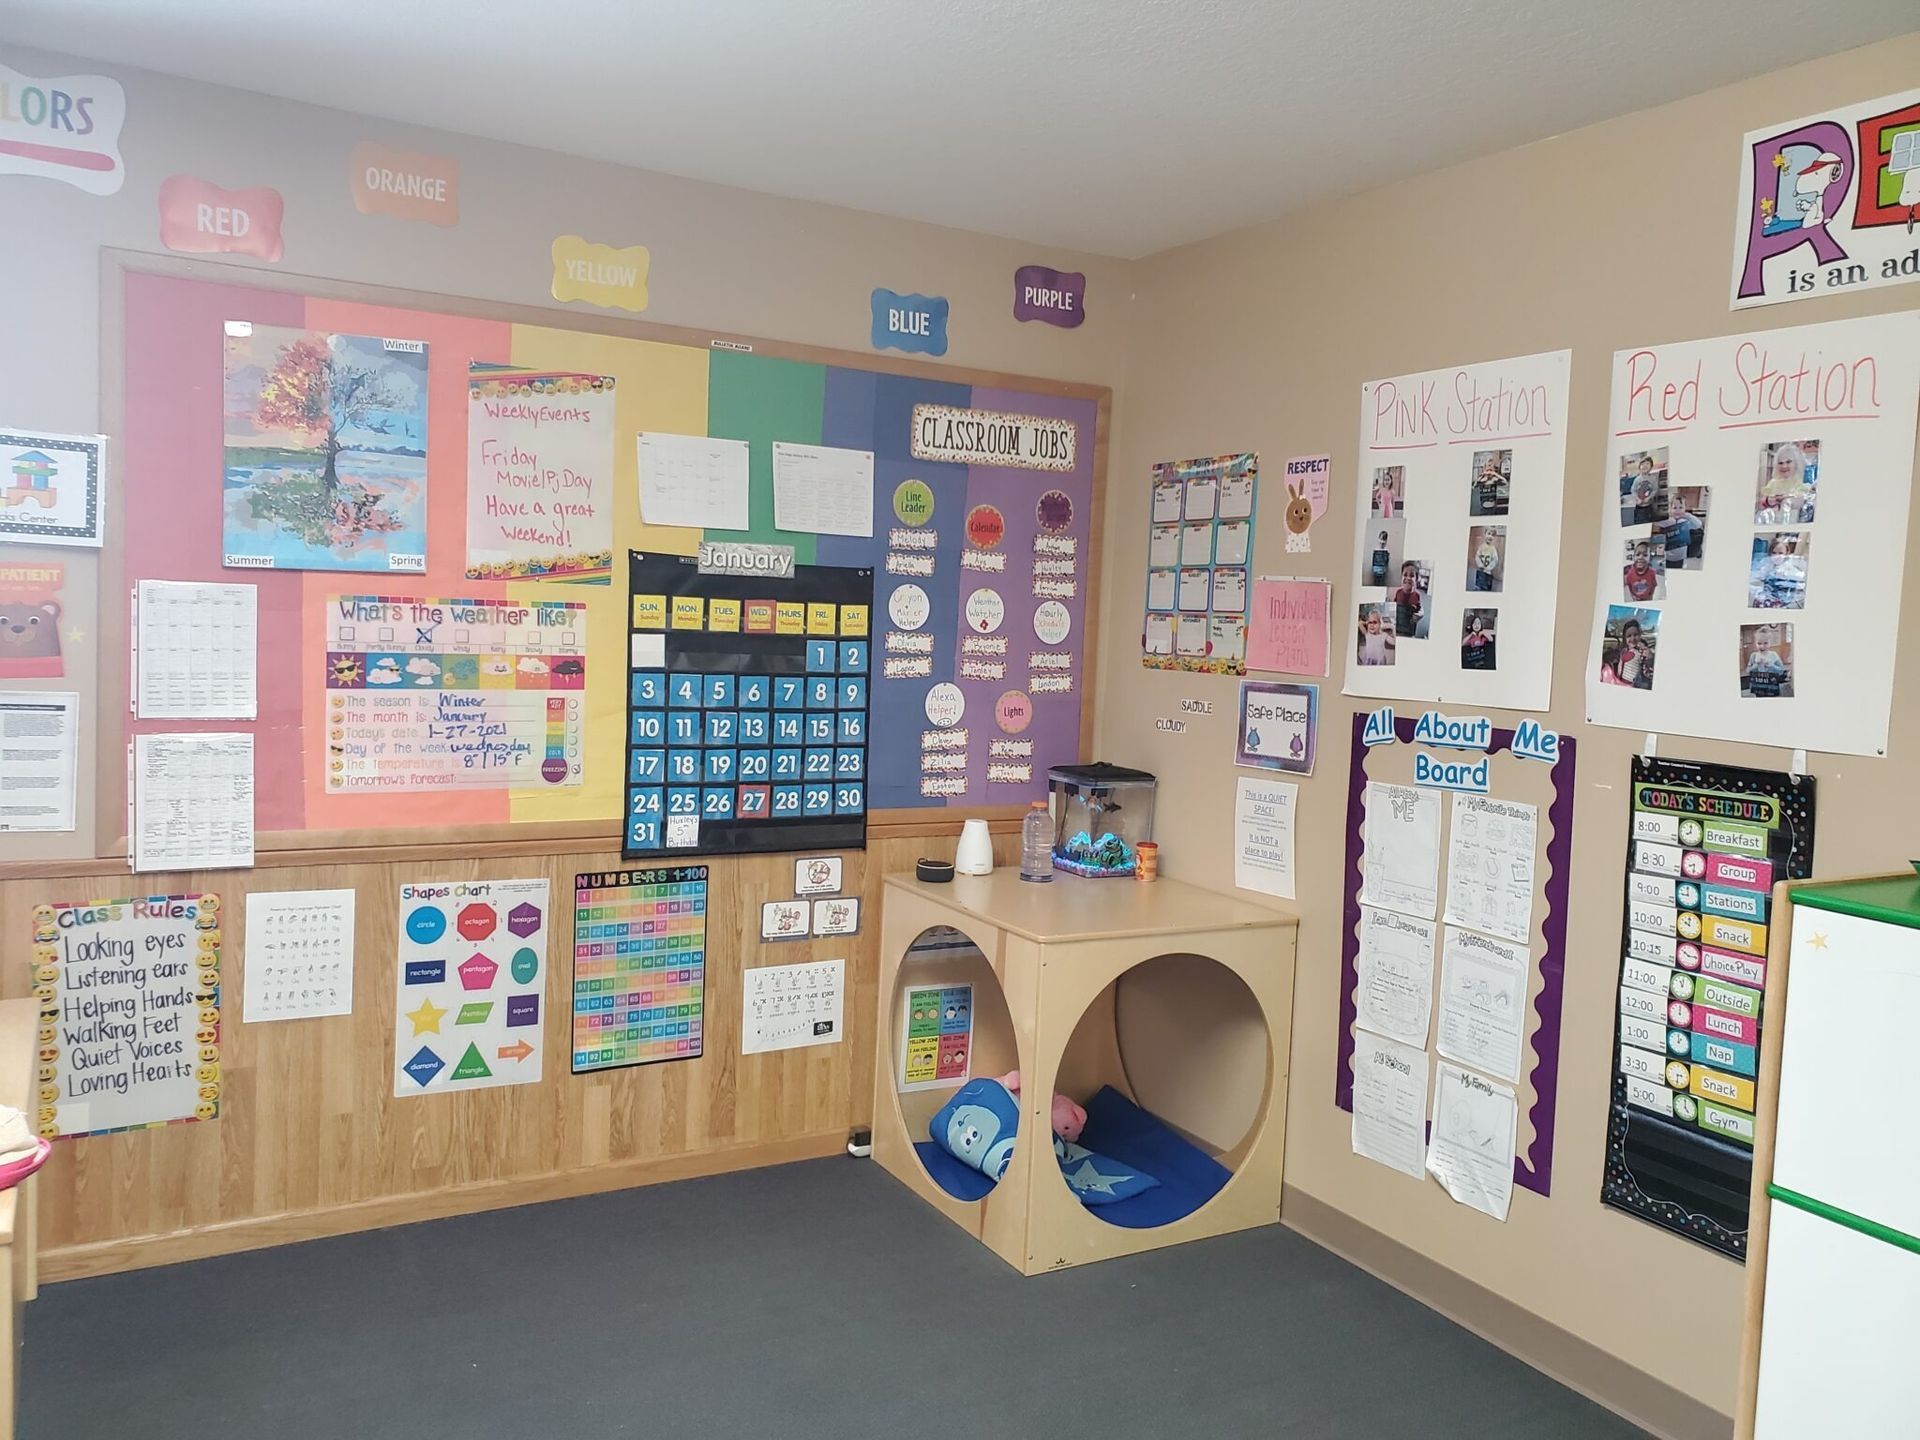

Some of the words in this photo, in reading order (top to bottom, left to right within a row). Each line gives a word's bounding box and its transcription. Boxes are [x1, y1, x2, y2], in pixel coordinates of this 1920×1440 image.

[366, 167, 446, 202] ORANGE
[197, 204, 249, 237] RED
[566, 259, 638, 288] YELLOW
[1787, 269, 1816, 294] is
[1826, 262, 1869, 288] an
[1025, 286, 1073, 311] PURPLE
[889, 308, 930, 336] BLUE
[384, 340, 419, 350] Winter
[1627, 350, 1702, 424] Red
[1718, 342, 1881, 417] Station
[1447, 372, 1552, 435] Station
[921, 416, 1022, 457] CLASSROOM
[1029, 426, 1069, 461] JOBS
[482, 440, 537, 470] Friday
[1287, 458, 1329, 475] RESPECT
[905, 489, 922, 502] Line
[486, 495, 529, 517] Have
[534, 501, 545, 516] a
[553, 502, 595, 532] great
[900, 502, 927, 515] Leader
[969, 520, 1001, 534] Calendar
[227, 555, 272, 566] Summer
[391, 556, 422, 567] Spring
[701, 546, 793, 577] January
[410, 603, 443, 623] the
[639, 603, 660, 613] SUN.
[676, 605, 700, 614] MON.
[714, 607, 736, 616] TUES.
[816, 647, 826, 665] 1
[847, 648, 859, 666] 2
[347, 696, 366, 707] The
[374, 697, 411, 707] season
[438, 692, 486, 707] Winter
[641, 680, 656, 699] 3
[678, 681, 693, 700] 4
[712, 681, 726, 700] 5
[748, 683, 761, 702] 6
[782, 684, 796, 702] 7
[815, 683, 828, 702] 8
[846, 684, 859, 703] 9
[931, 688, 956, 702] Alexa
[433, 707, 488, 723] January
[1003, 705, 1024, 719] Lights
[1181, 700, 1213, 714] SADDLE
[1247, 704, 1273, 721] Safe
[1275, 706, 1306, 723] Place
[637, 718, 660, 737] 10
[676, 719, 692, 737] 11
[711, 719, 731, 738] 12
[744, 719, 763, 738] 13
[779, 719, 798, 738] 14
[811, 719, 830, 738] 15
[843, 718, 861, 736] 16
[1156, 719, 1186, 733] CLOUDY
[1365, 708, 1393, 737] All
[1415, 712, 1490, 744] About
[1514, 720, 1558, 755] Me
[637, 757, 659, 776] 17
[674, 756, 695, 775] 18
[711, 756, 731, 775] 19
[742, 756, 767, 775] 20
[776, 755, 796, 774] 21
[807, 754, 831, 773] 22
[838, 754, 861, 772] 23
[1415, 753, 1488, 787] Board
[633, 794, 660, 814] 24
[670, 794, 696, 813] 25
[706, 794, 731, 813] 26
[742, 793, 767, 812] 27
[775, 791, 799, 810] 28
[806, 790, 830, 809] 29
[838, 789, 861, 808] 30
[1268, 793, 1287, 803] QUIET
[1641, 789, 1695, 812] TODAY'S
[1699, 796, 1770, 821] SCHEDULE
[633, 823, 655, 842] 31
[1638, 820, 1661, 833] 8:00
[1707, 830, 1760, 849] Breakfast
[673, 866, 707, 880] 1-100
[1720, 864, 1756, 881] Group
[403, 885, 450, 901] Shapes
[454, 883, 491, 897] Chart
[1637, 882, 1660, 896] 9:00
[1707, 893, 1754, 911] Stations
[57, 903, 122, 929] Class
[132, 899, 197, 920] Rules
[416, 920, 436, 929] circle
[464, 917, 490, 926] octagon
[511, 915, 539, 924] hexagon
[1634, 911, 1663, 927] 10:00
[1716, 929, 1750, 945] Snack
[64, 932, 134, 966] Looking
[145, 932, 186, 959] eyes
[1633, 940, 1662, 955] 10:15
[65, 964, 146, 991] Listening
[151, 961, 189, 978] ears
[409, 966, 441, 977] rectangle
[462, 965, 494, 975] pentagon
[1627, 968, 1656, 986] 11:00
[1706, 989, 1750, 1011] Outside
[63, 994, 136, 1023] Helping
[142, 986, 193, 1013] Hands
[512, 1006, 534, 1016] square
[1625, 996, 1654, 1012] 12:00
[1707, 1014, 1741, 1035] Lunch
[63, 1019, 136, 1046] Walking
[143, 1012, 182, 1035] Feet
[1626, 1025, 1649, 1040] 1:00
[1709, 1046, 1732, 1062] Nap
[71, 1044, 121, 1071] Quiet
[129, 1039, 183, 1062] Voices
[410, 1061, 438, 1071] diamond
[458, 1064, 485, 1075] triangle
[1625, 1056, 1648, 1072] 3:30
[1703, 1078, 1736, 1097] Snack
[68, 1068, 128, 1098] Loving
[132, 1060, 192, 1085] Hearts
[1633, 1086, 1655, 1102] 5:00
[1709, 1111, 1739, 1130] Gym
